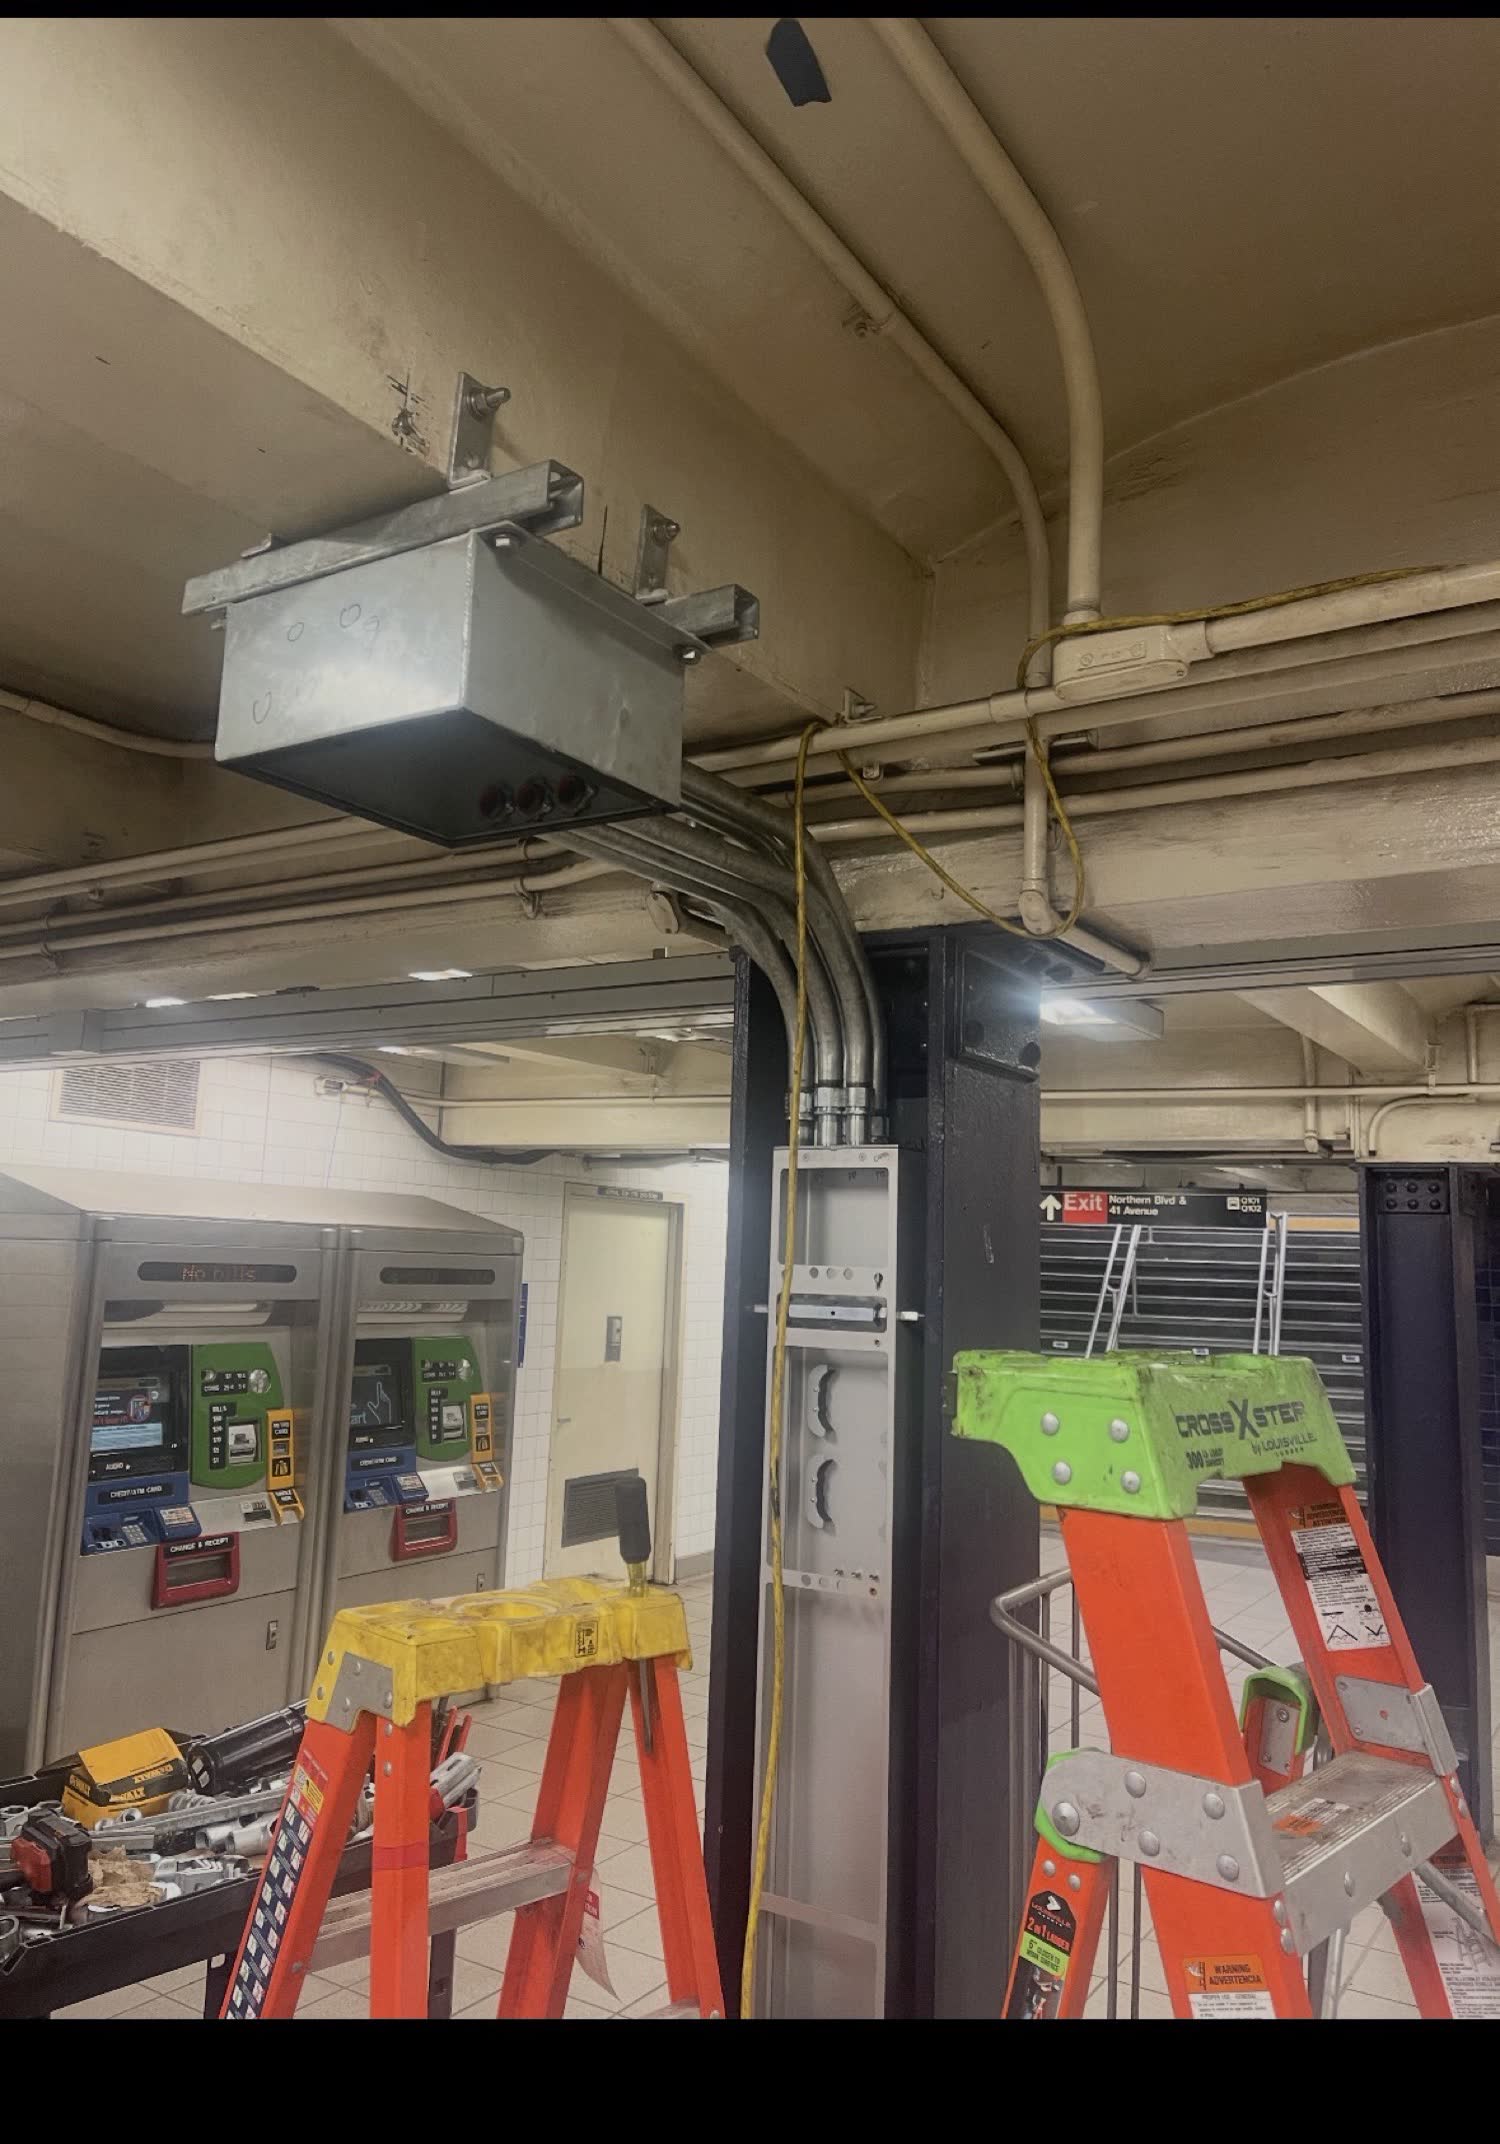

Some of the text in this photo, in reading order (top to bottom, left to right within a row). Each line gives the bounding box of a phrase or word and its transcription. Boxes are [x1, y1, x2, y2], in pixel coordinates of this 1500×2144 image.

[1063, 1193, 1103, 1212] Exit
[1109, 1195, 1187, 1206] Northern Blvd &
[1109, 1206, 1159, 1216] 41 Avenue
[1175, 1410, 1235, 1439] CROSS
[1252, 1400, 1305, 1428] STEP
[1261, 1432, 1318, 1452] LOUISVILLE
[106, 1462, 124, 1471] AUDIO
[170, 1542, 196, 1554] CHANGE
[204, 1536, 229, 1548] RECEIPT
[1214, 1963, 1251, 1975] WARNING
[1209, 1974, 1263, 1986] ADVERTENCIA
